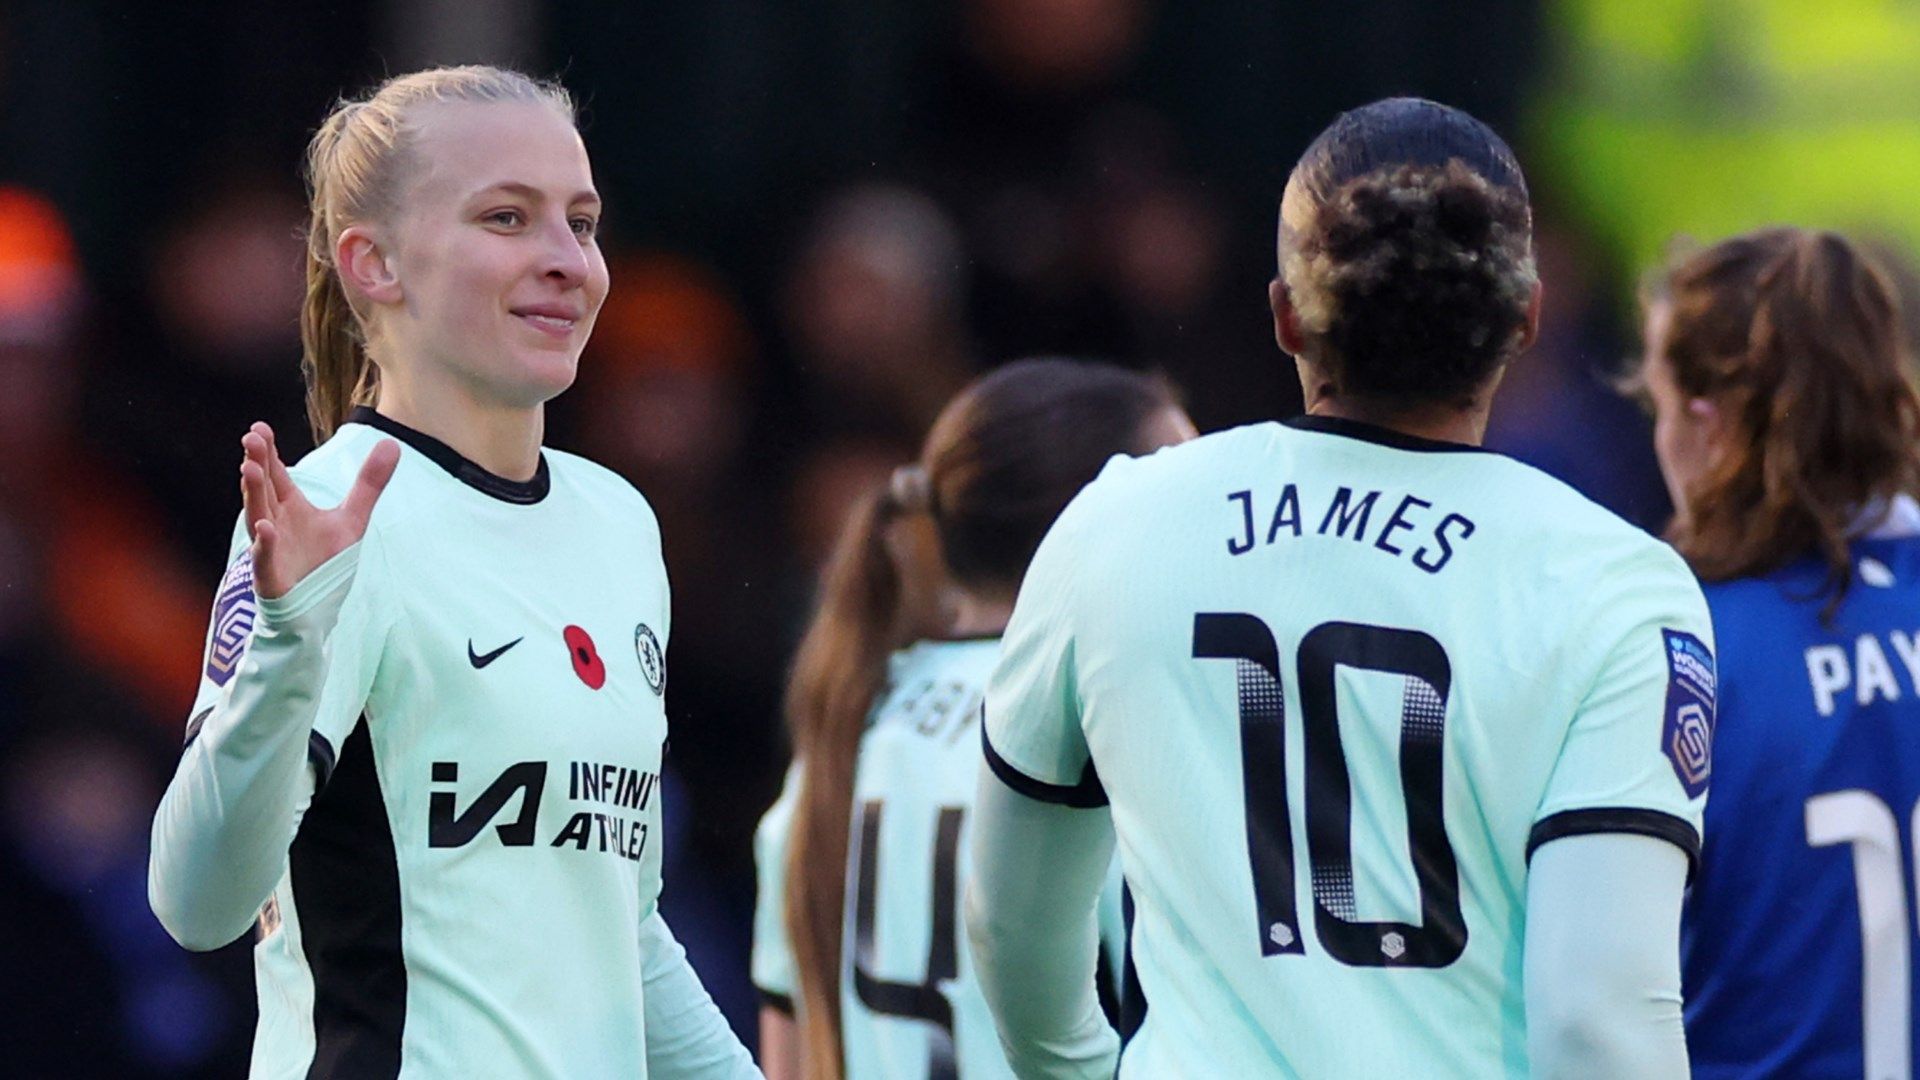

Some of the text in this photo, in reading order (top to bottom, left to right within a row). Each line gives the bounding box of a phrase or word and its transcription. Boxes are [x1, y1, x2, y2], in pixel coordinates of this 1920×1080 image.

[1226, 484, 1475, 574] JAMES
[1192, 612, 1469, 968] 10
[1804, 789, 1920, 1080] 1
